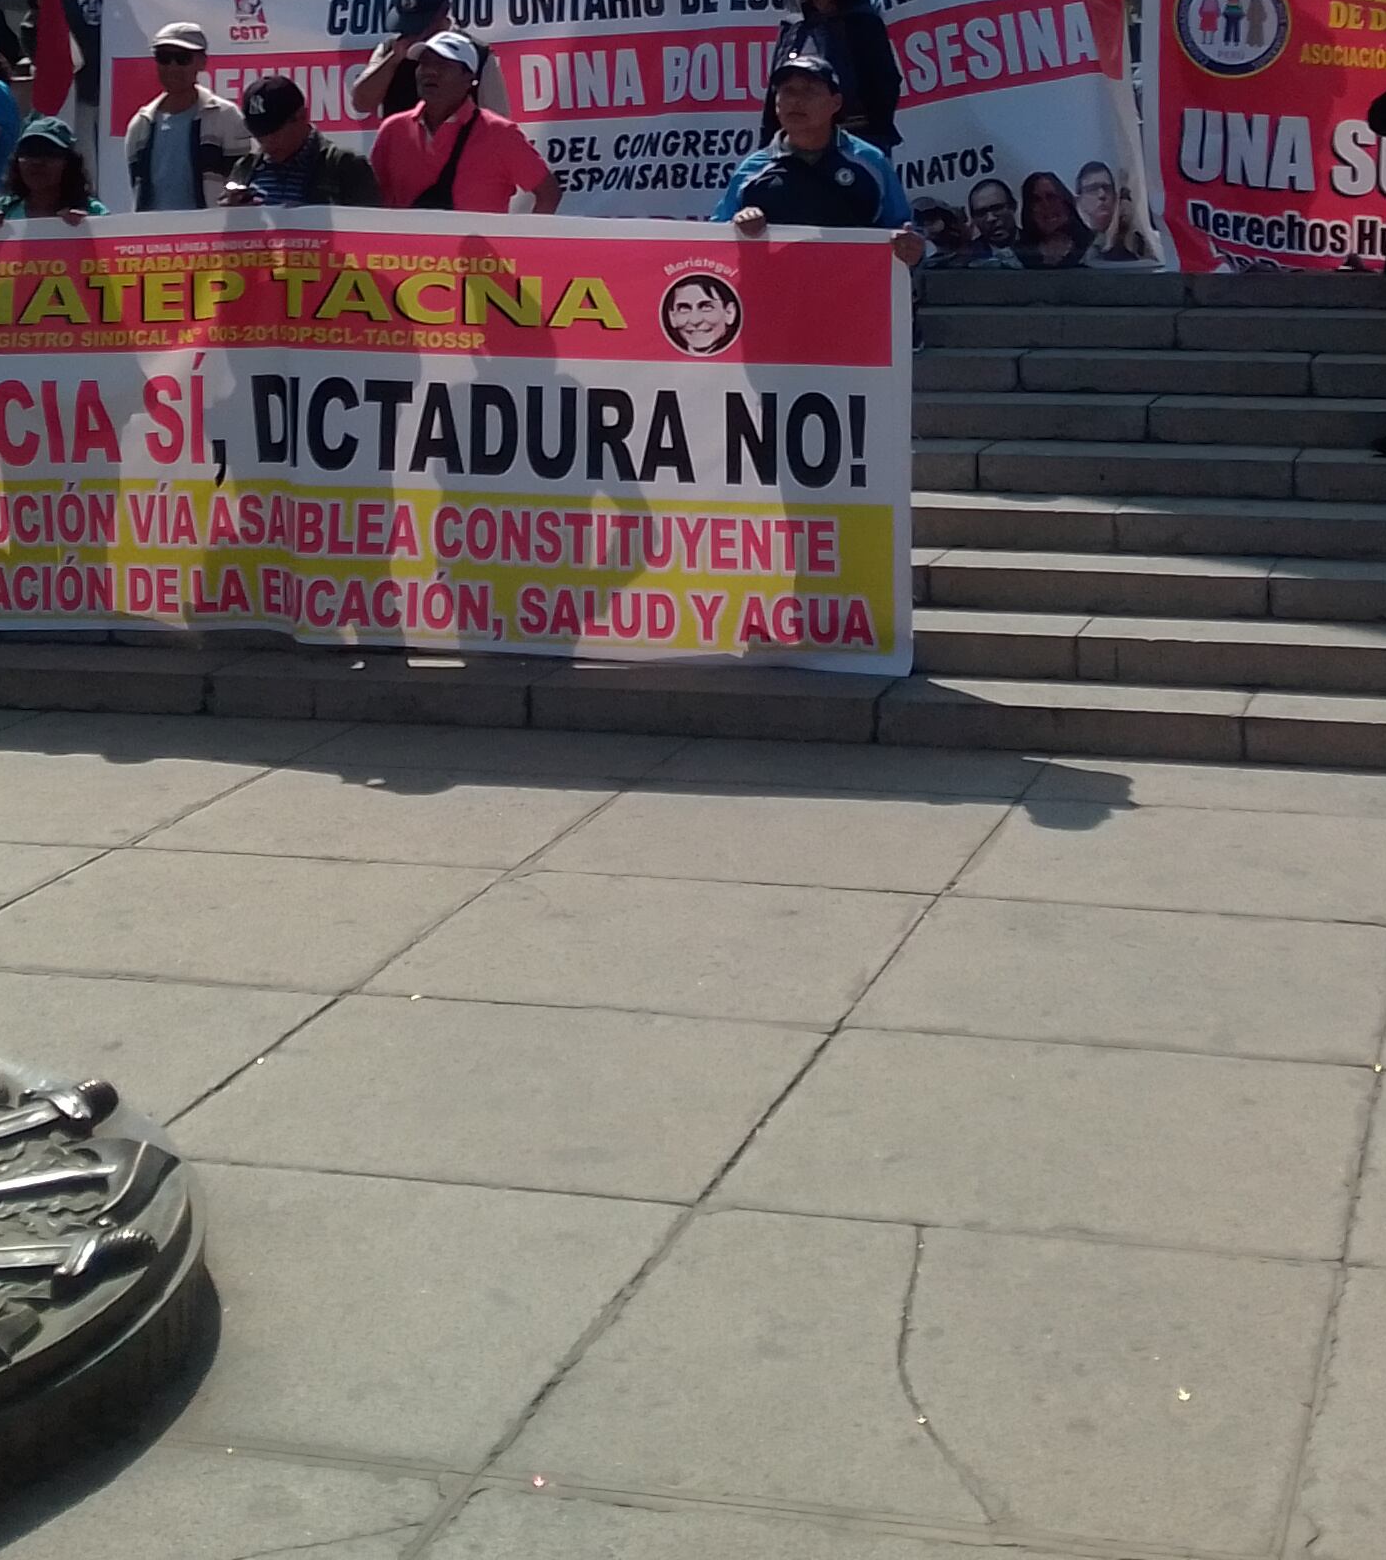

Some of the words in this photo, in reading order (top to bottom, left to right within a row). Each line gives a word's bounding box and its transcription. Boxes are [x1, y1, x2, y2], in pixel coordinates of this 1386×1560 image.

[1328, 0, 1365, 31] DE
[519, 48, 646, 112] DINA
[547, 136, 601, 164] DEL
[613, 128, 754, 161] CONGRESO
[1178, 107, 1316, 192] UNA
[555, 161, 735, 193] ESPONSABLES
[1189, 199, 1348, 257] Derechos
[80, 258, 110, 274] DE
[116, 250, 284, 273] TRABAJADORES
[287, 251, 320, 268] EN
[328, 253, 360, 270] LA
[367, 253, 516, 274] EDUCACIÓN
[272, 267, 628, 329] TACNA
[80, 328, 172, 348] SINDICAL
[143, 352, 227, 487] SÍ,
[250, 373, 696, 484] DICTADURA
[724, 390, 867, 489] NO!
[129, 482, 197, 546] VÍA
[432, 506, 837, 573] CONSTITUYENTE
[127, 567, 180, 614] DE
[191, 568, 250, 615] LA
[519, 586, 675, 641] SALUD
[689, 592, 724, 642] Y
[738, 596, 875, 647] AGUA
